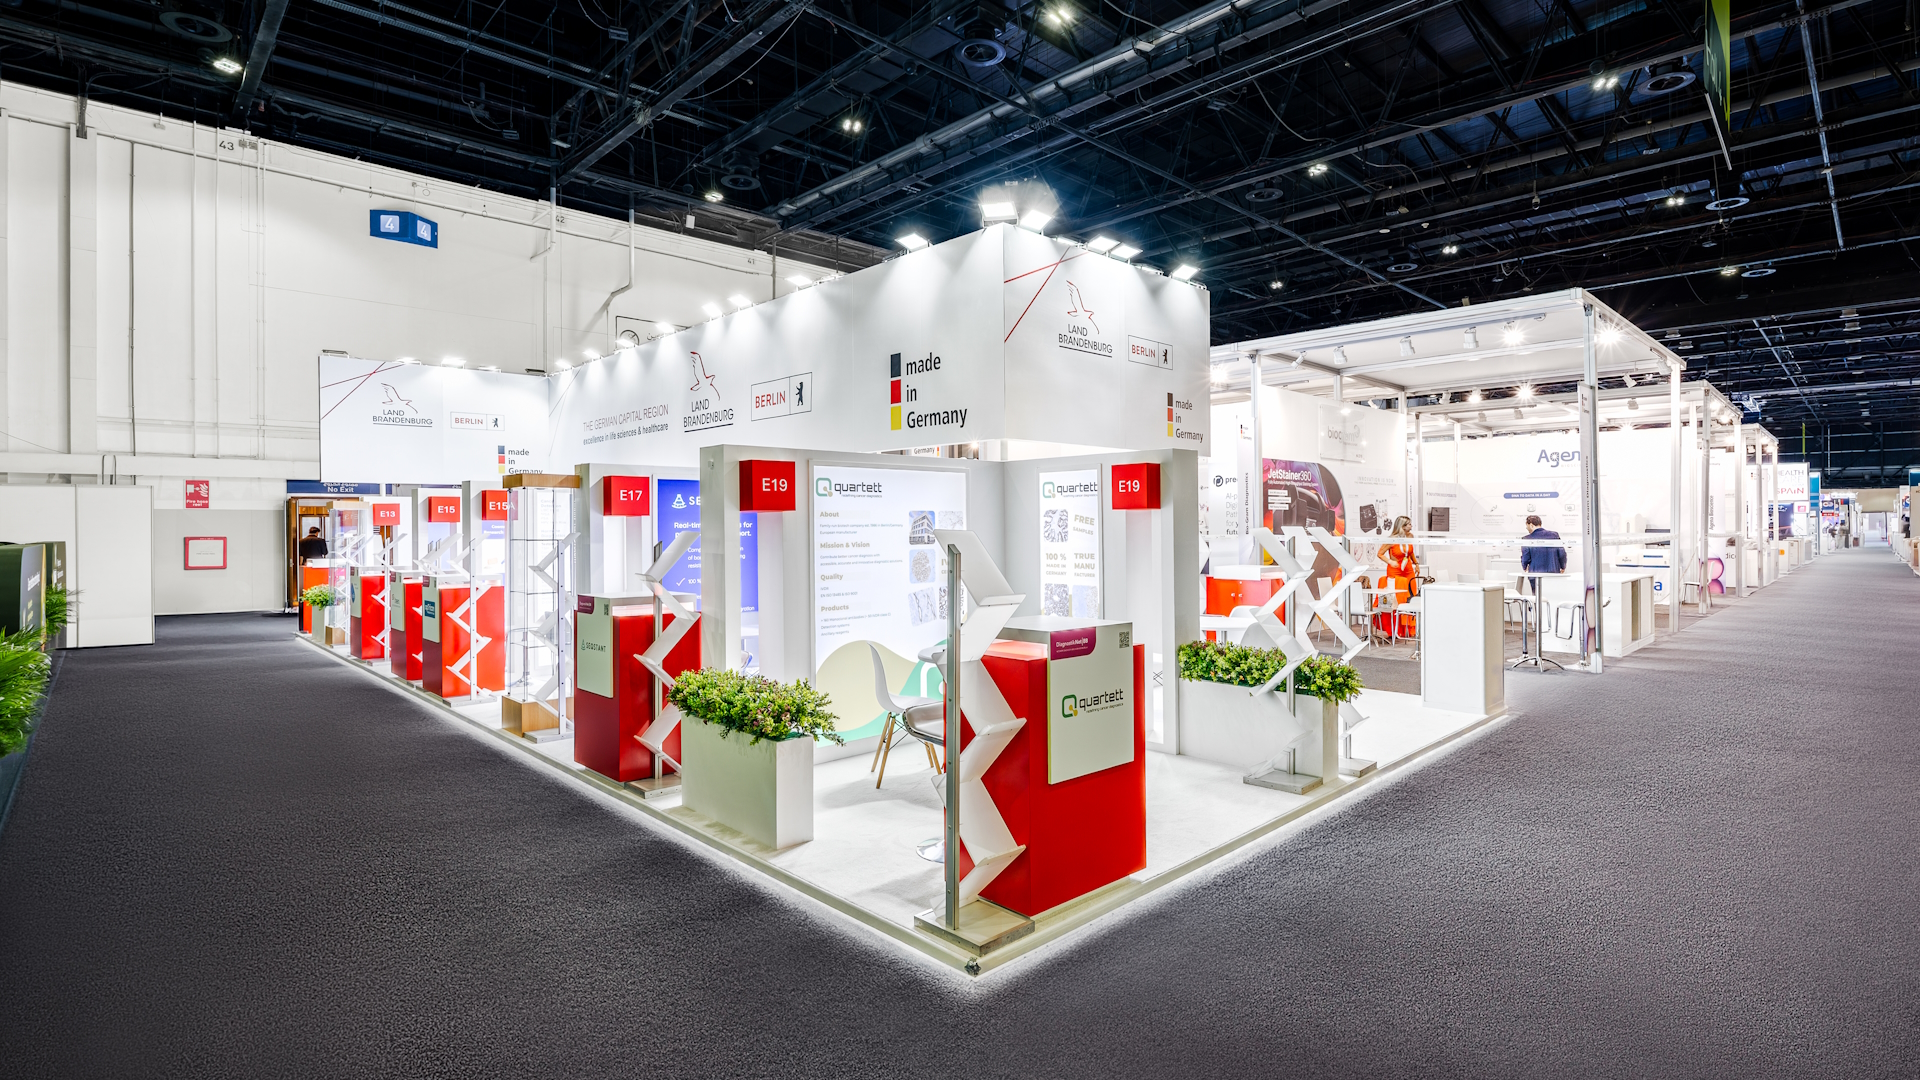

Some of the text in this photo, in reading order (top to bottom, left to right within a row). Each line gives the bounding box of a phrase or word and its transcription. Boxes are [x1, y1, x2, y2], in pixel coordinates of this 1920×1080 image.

[219, 139, 234, 151] 43
[384, 218, 394, 230] 4
[555, 215, 565, 224] 42
[420, 226, 428, 238] 4
[1068, 324, 1088, 336] LAND
[1058, 334, 1112, 354] BRANDENBURG
[1132, 345, 1156, 359] BERLIN
[906, 352, 942, 376] made
[755, 390, 786, 408] BERLIN
[906, 384, 918, 402] in
[691, 398, 710, 412] LAND
[1175, 398, 1192, 410] made
[372, 415, 433, 425] BRANDENBURG
[583, 404, 668, 432] THE GERMAN CAPITAL REGION
[684, 408, 734, 428] BRANDENBURG
[906, 406, 968, 429] Germany
[1176, 412, 1182, 424] in
[583, 435, 604, 445] excellence
[605, 433, 609, 441] in
[617, 428, 636, 439] sciences
[638, 426, 641, 435] &
[642, 422, 668, 434] healthcare
[1175, 428, 1204, 443] Germany
[508, 448, 530, 456] made
[1537, 449, 1580, 468] Agen
[1268, 469, 1311, 481] JetStainer360
[762, 478, 788, 492] E19
[834, 482, 882, 494] quartett
[1057, 482, 1098, 495] quartett
[1118, 480, 1140, 492] E19
[620, 490, 642, 501] E17
[689, 496, 701, 505] SE
[489, 501, 515, 510] E15A
[1226, 502, 1238, 510] Digi
[1074, 514, 1095, 526] FREE
[1073, 527, 1094, 535] SAMPLES
[1079, 688, 1123, 711] quartett
